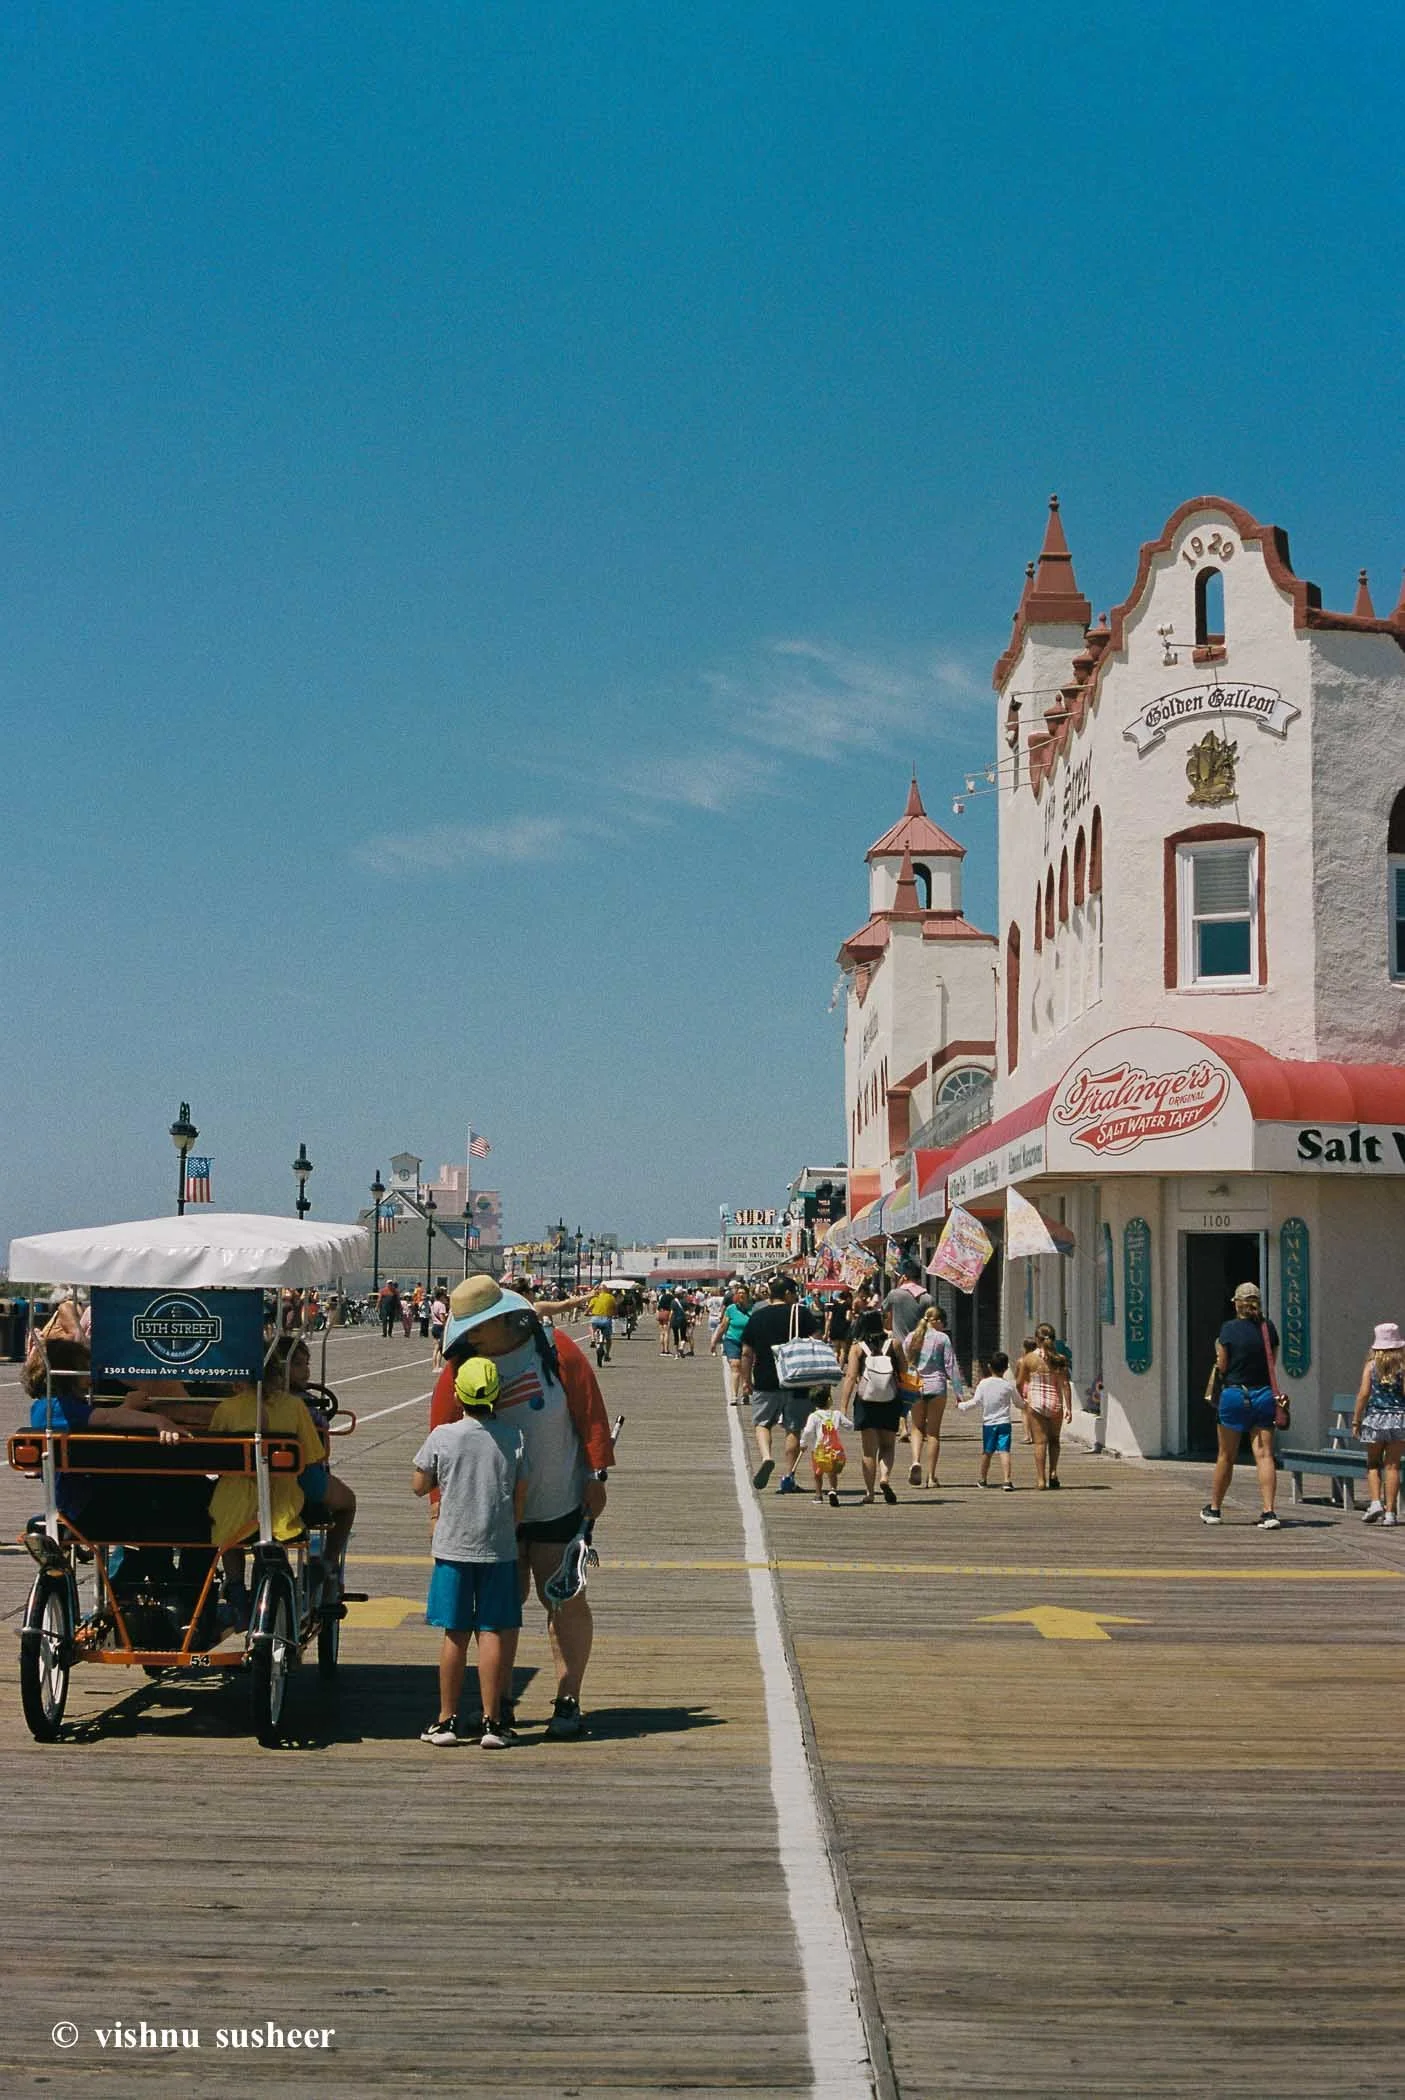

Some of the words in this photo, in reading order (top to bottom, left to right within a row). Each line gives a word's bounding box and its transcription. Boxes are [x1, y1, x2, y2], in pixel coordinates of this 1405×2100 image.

[1182, 532, 1235, 570] 1929
[1145, 695, 1204, 728] Golden
[1207, 687, 1276, 715] Galleon
[1057, 1064, 1212, 1121] Fralinger's
[1168, 1092, 1206, 1107] ORIGINAL
[1096, 1120, 1128, 1145] SALT
[1127, 1114, 1166, 1134] WATER
[1168, 1106, 1204, 1128] TAFFY
[1297, 1129, 1382, 1163] Salt
[734, 1208, 776, 1226] SURF
[1202, 1215, 1231, 1228] 1100
[1129, 1250, 1145, 1342] FUDGE
[1287, 1238, 1301, 1358] MACAROONS
[140, 1322, 168, 1334] 13TH
[170, 1322, 215, 1335] STREET
[104, 1367, 126, 1375] 1301
[128, 1366, 158, 1375] Ocean
[159, 1367, 178, 1375] Ave
[188, 1367, 250, 1376] 609-399-7121
[191, 1655, 210, 1668] 54
